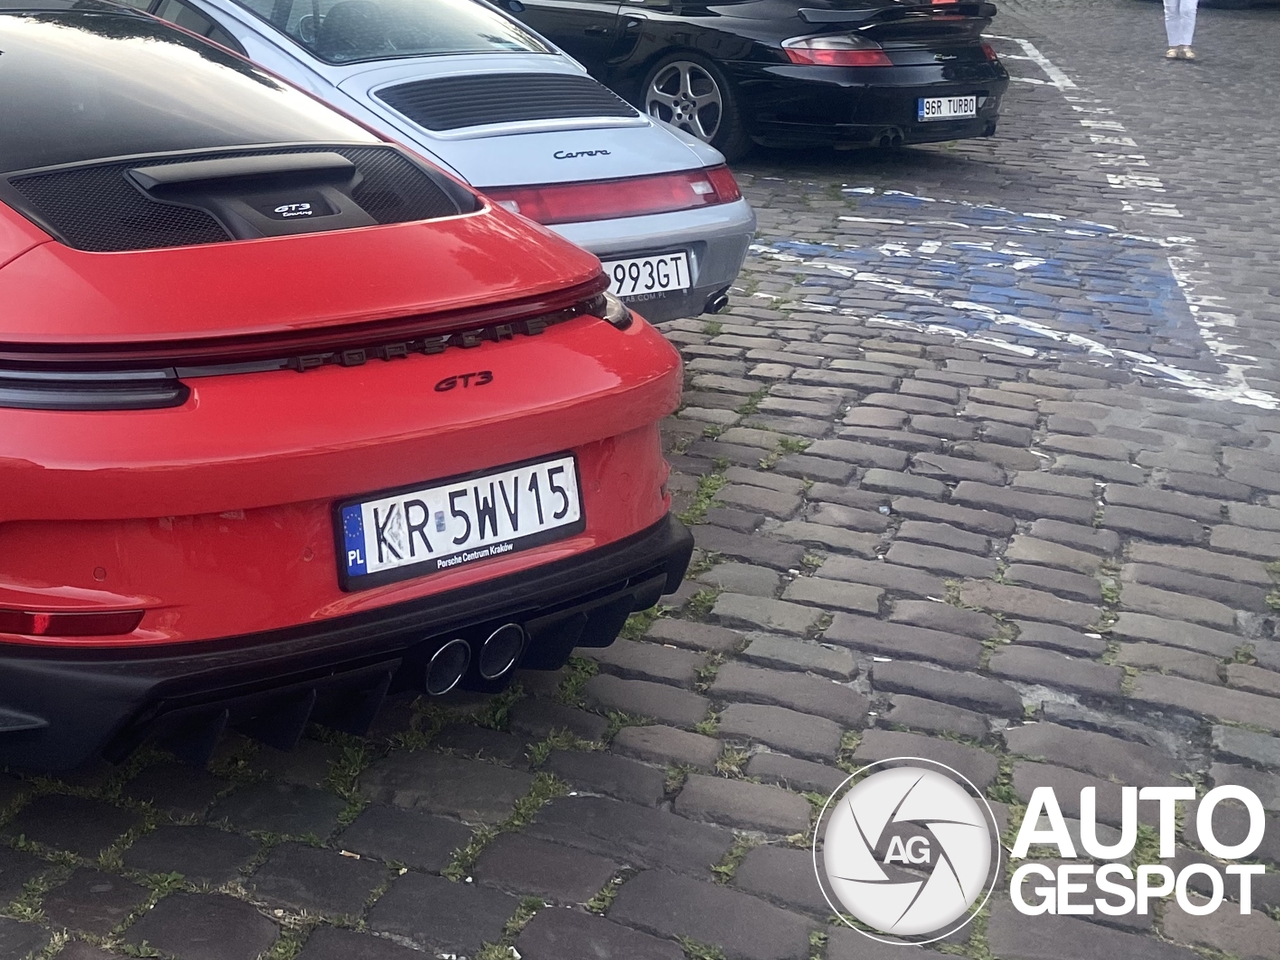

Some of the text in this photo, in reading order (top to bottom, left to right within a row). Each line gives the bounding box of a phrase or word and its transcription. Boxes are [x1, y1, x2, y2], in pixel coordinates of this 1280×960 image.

[925, 100, 942, 115] 96R
[553, 148, 611, 160] Carrera
[274, 203, 311, 213] GT3
[282, 210, 313, 218] touring
[296, 317, 548, 373] PORSCHE
[433, 370, 494, 393] GT3
[373, 465, 570, 564] KR 5WV15
[348, 549, 365, 567] PL
[436, 542, 514, 569] Porsche Centrum Kraków
